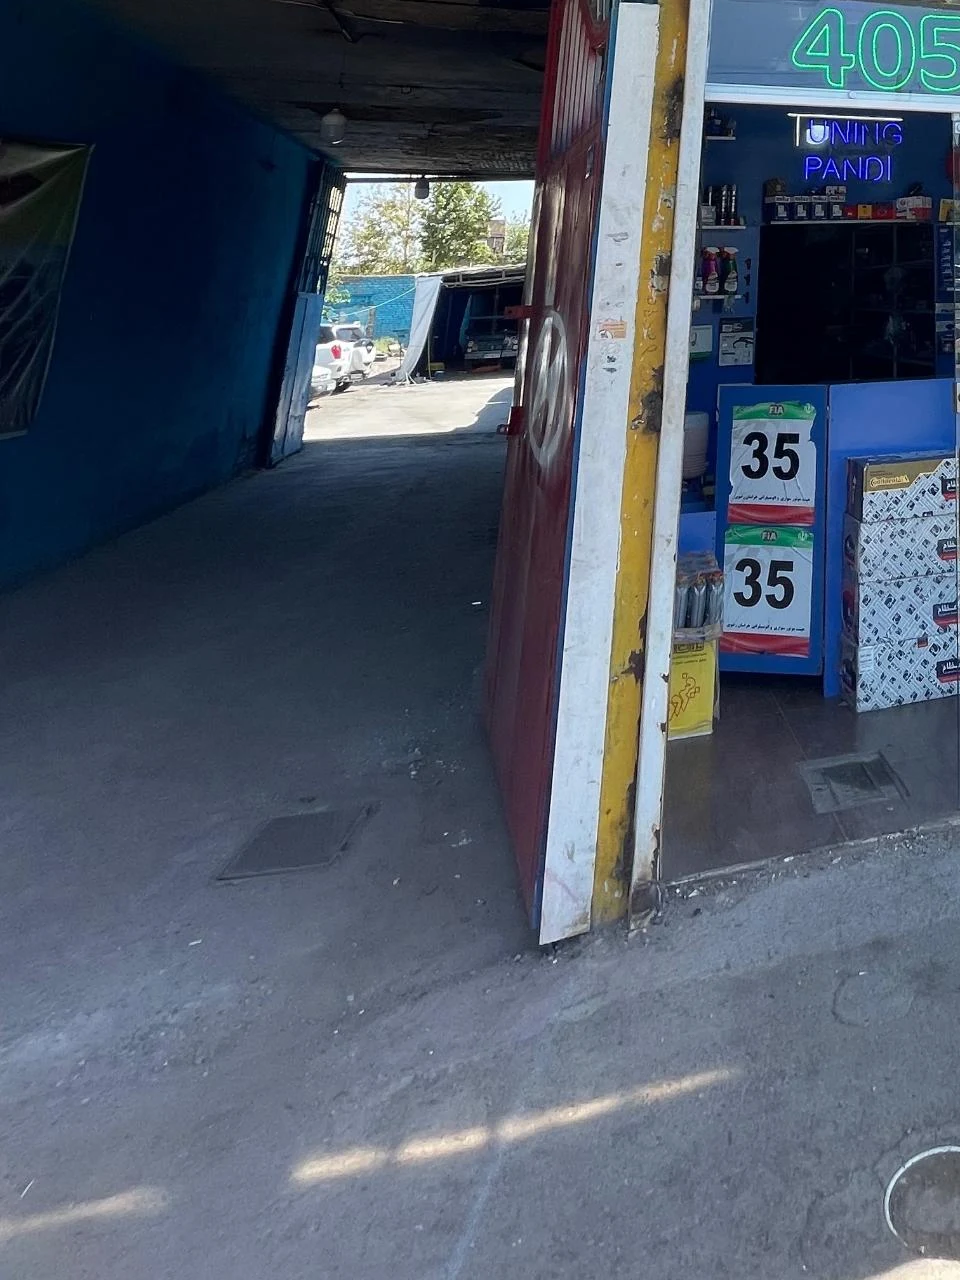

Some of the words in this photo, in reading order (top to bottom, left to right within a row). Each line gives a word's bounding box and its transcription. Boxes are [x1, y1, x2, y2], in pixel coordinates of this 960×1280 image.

[804, 155, 893, 181] PANDI
[769, 405, 784, 415] FIA
[741, 431, 800, 480] 35
[762, 531, 777, 540] FIA
[733, 558, 795, 610] 35
